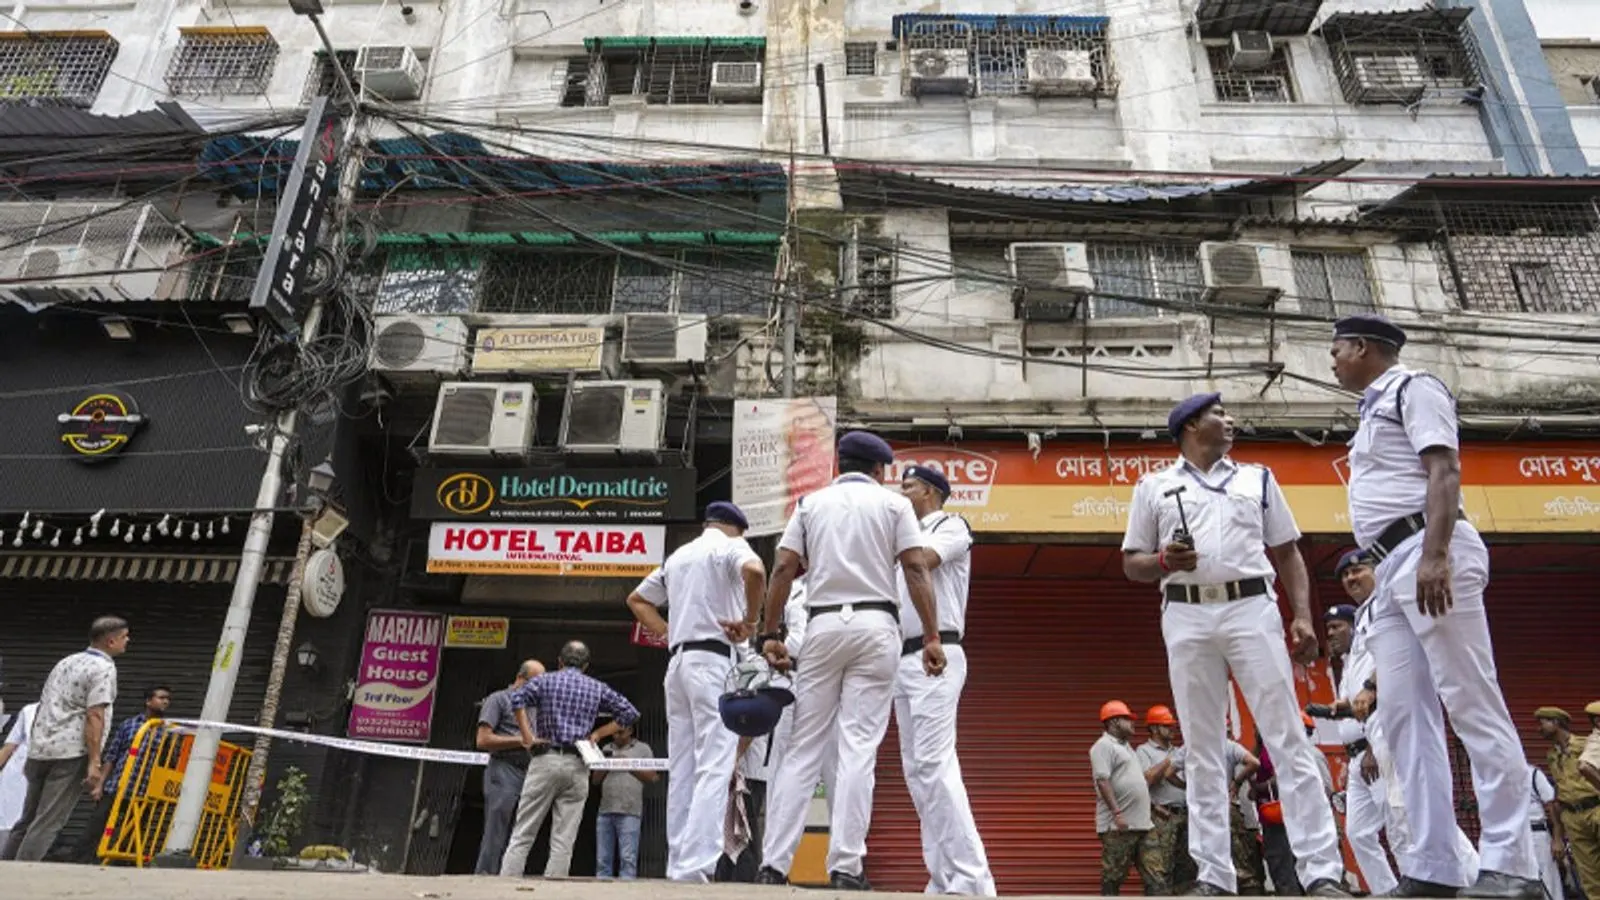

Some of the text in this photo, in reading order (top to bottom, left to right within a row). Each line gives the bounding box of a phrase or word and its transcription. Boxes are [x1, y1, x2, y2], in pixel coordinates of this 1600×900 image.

[740, 441, 778, 456] PARK
[501, 475, 668, 497] Hotel Demattrie
[444, 528, 648, 555] HOTEL TAIBA
[506, 552, 583, 561] INTERNATIONAL
[368, 616, 441, 647] MARIAM
[372, 647, 430, 664] Guest
[366, 666, 429, 682] House
[386, 692, 414, 704] Floor
